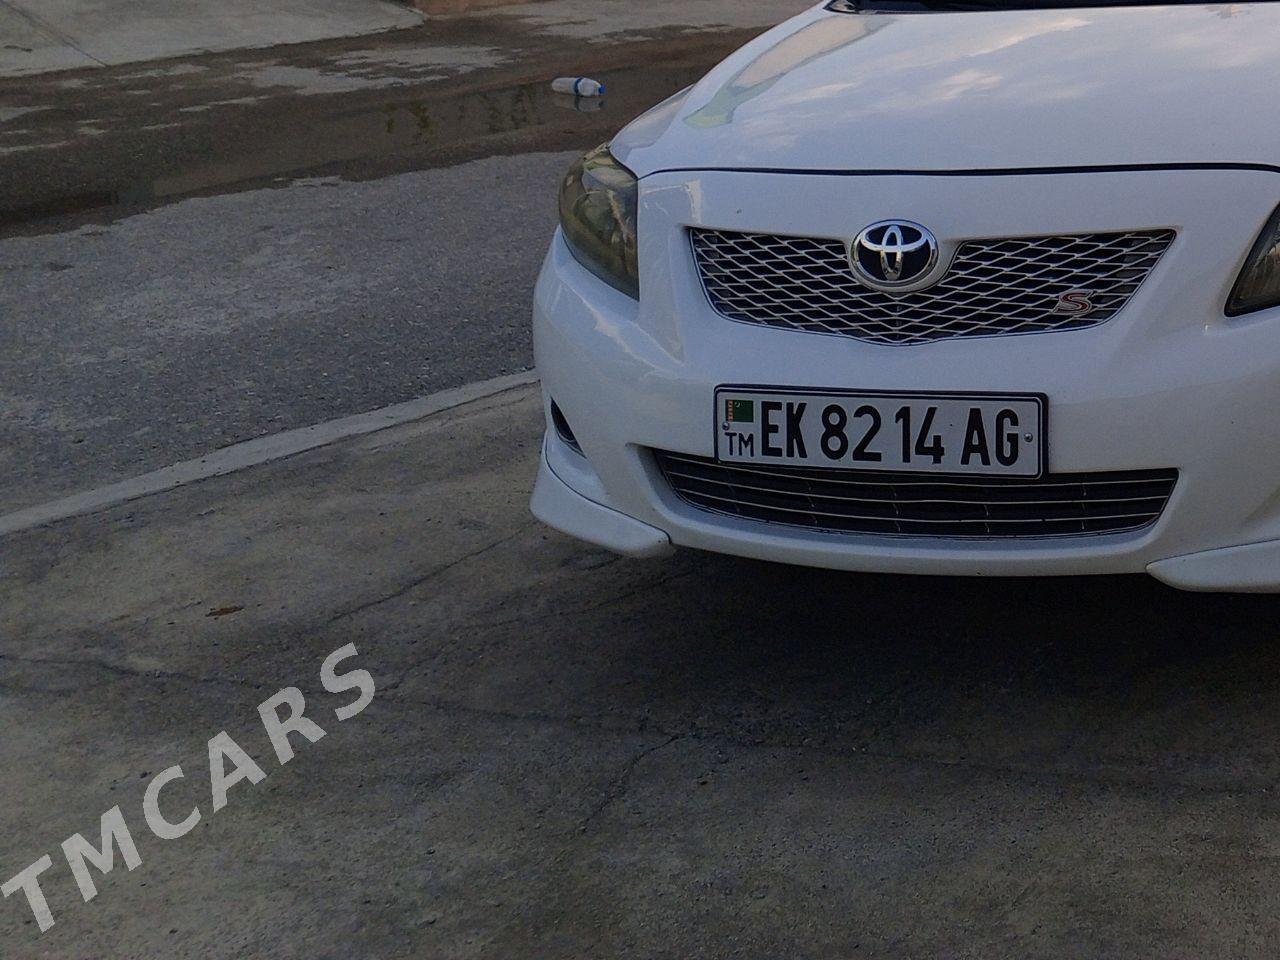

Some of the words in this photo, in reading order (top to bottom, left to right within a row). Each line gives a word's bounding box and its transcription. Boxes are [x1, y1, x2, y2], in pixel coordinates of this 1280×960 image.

[724, 431, 755, 457] TM
[760, 400, 808, 459] EK
[960, 407, 1019, 466] AG
